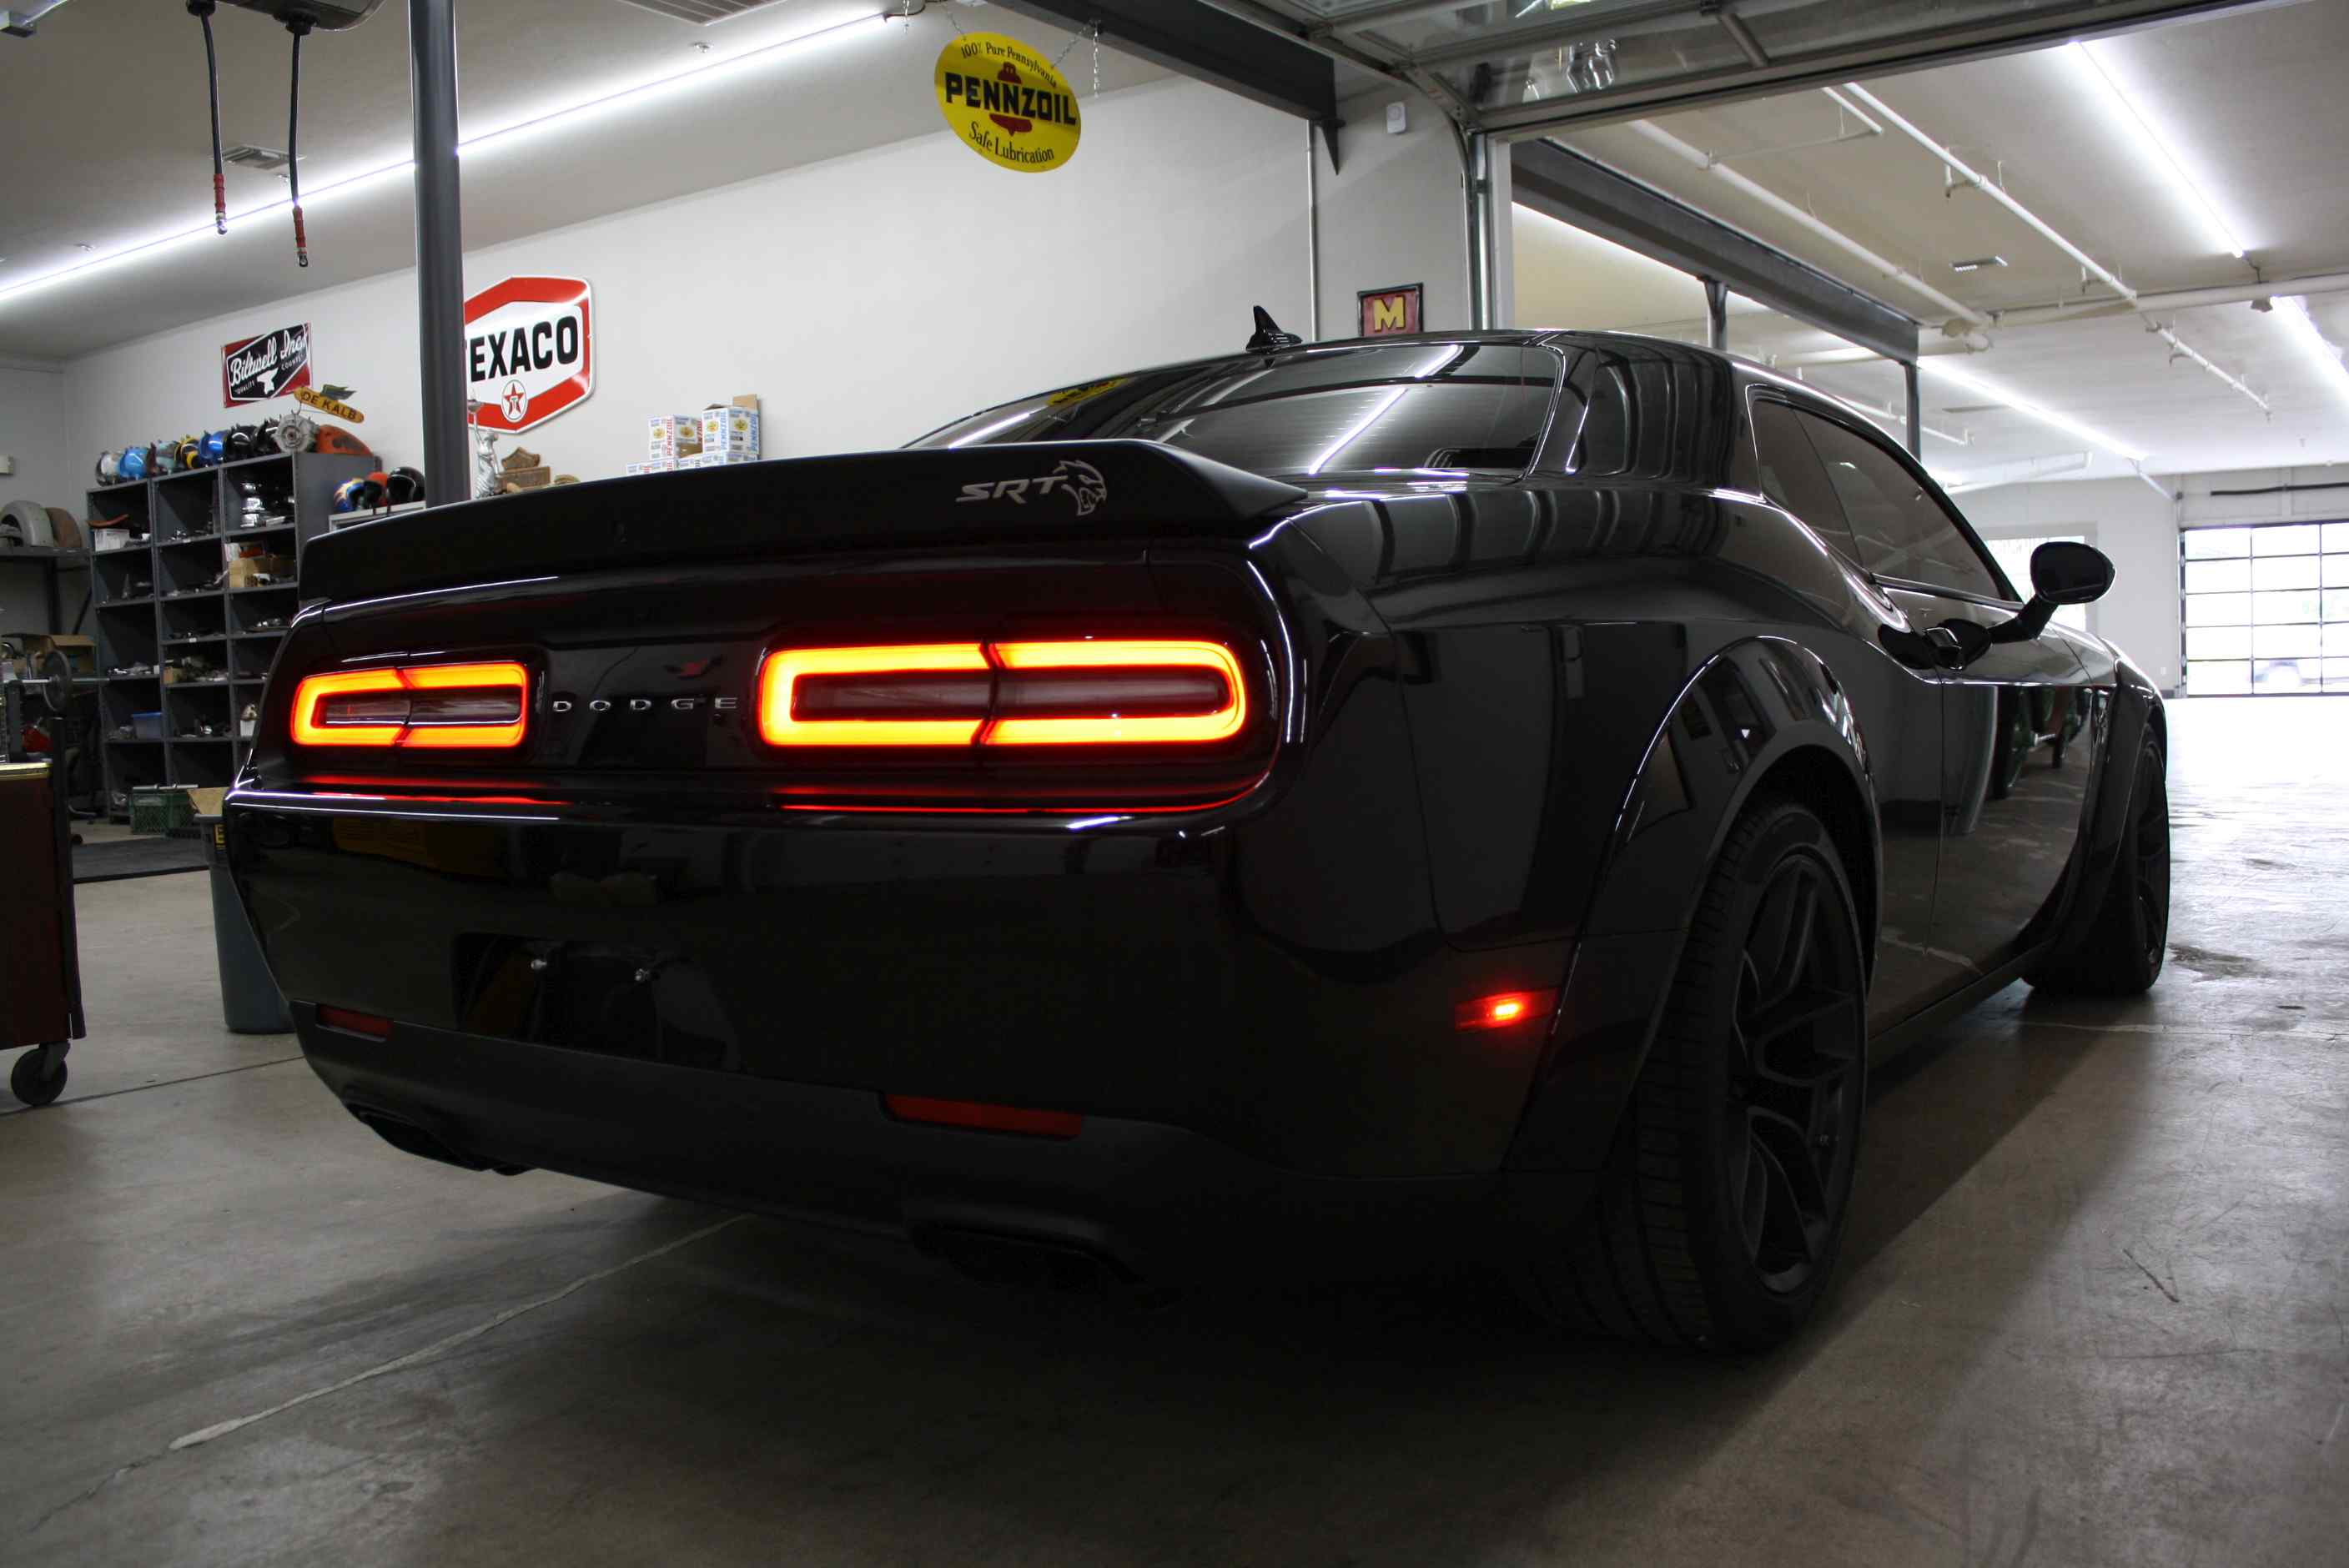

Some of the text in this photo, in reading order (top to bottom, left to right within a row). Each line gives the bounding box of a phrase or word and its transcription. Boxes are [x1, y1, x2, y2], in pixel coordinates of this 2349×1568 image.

[986, 42, 1005, 57] Pure
[1008, 46, 1057, 88] Pennsylvania
[945, 72, 1077, 126] PENNZOIL
[968, 121, 1054, 163] Safe Lubrication
[1374, 295, 1406, 332] M
[230, 337, 278, 387] Biltwell
[465, 315, 578, 382] EXACO
[301, 392, 357, 420] DE KALB
[956, 475, 1069, 504] SRT
[553, 697, 737, 712] DODGE
